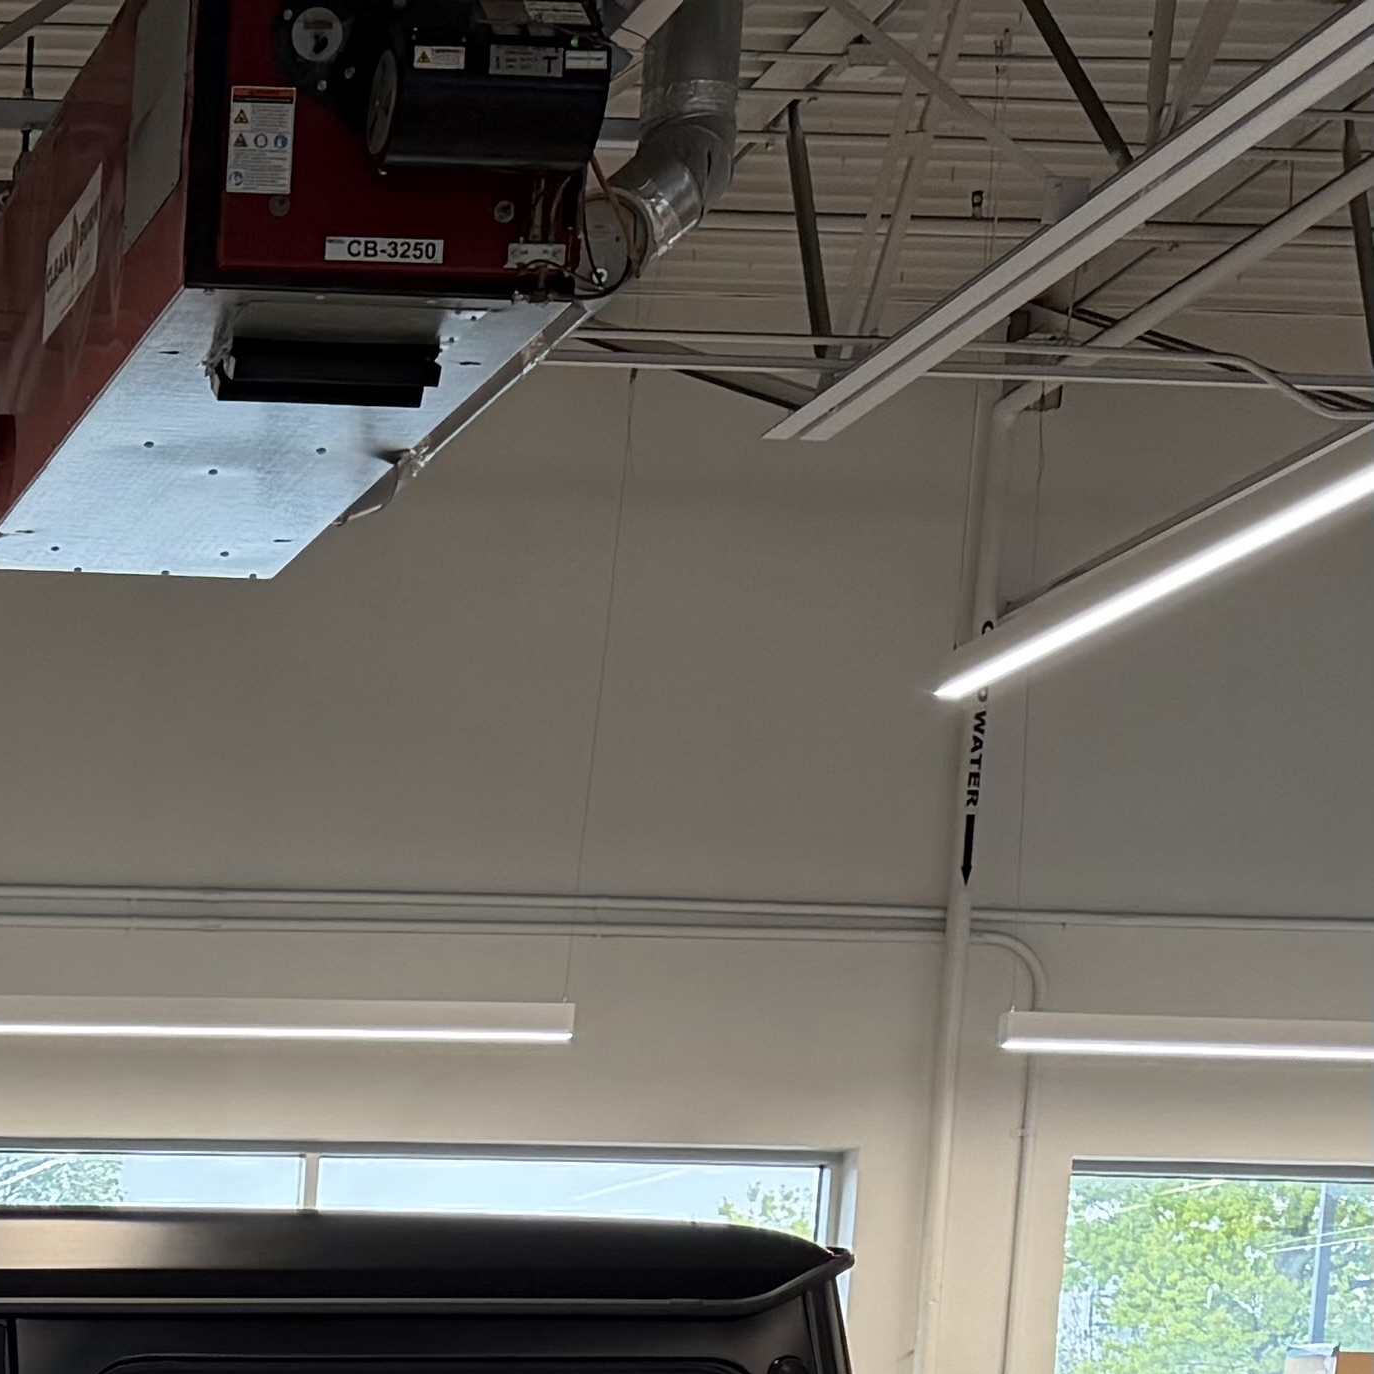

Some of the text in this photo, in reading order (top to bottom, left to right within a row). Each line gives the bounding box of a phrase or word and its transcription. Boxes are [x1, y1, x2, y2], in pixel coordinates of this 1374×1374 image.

[347, 239, 437, 260] CB-3250
[965, 620, 994, 806] CD WATER
